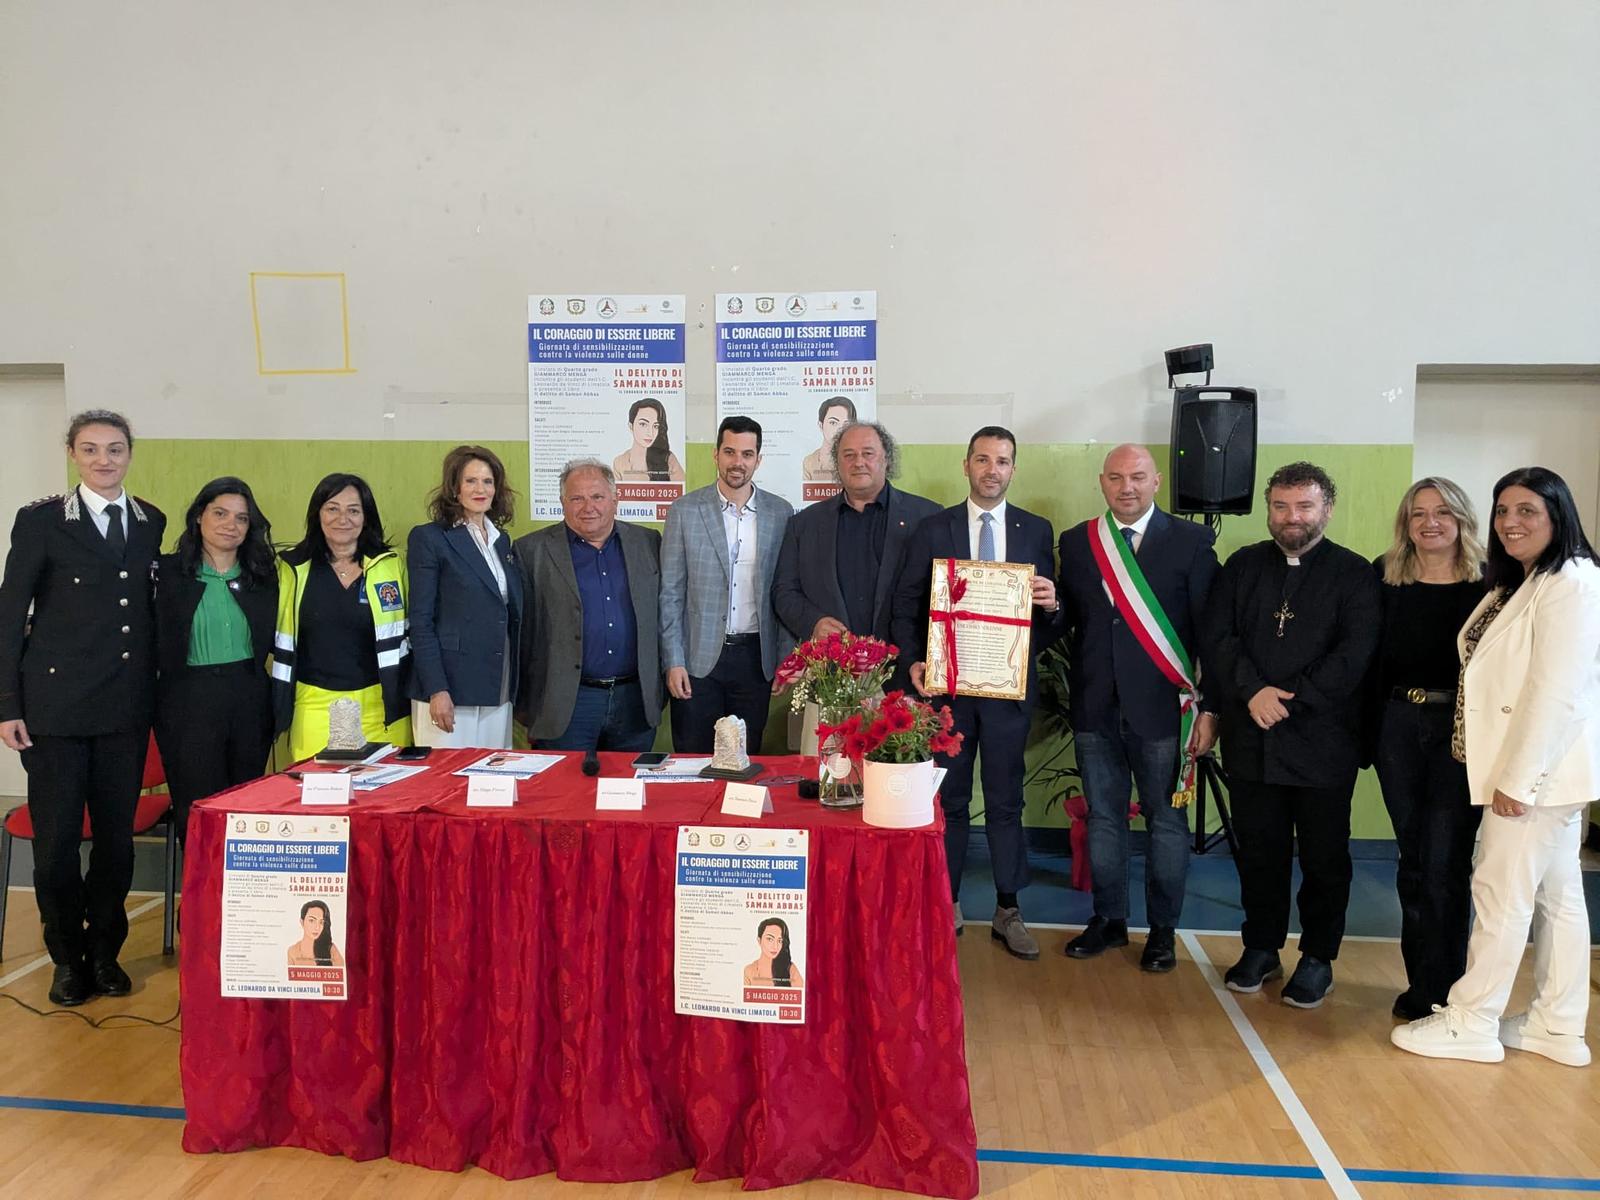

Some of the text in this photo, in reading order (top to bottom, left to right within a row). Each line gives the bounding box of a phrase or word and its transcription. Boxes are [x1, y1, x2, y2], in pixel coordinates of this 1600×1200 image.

[533, 328, 676, 340] IL CORAGGIO DI ESSERE LIBERE
[721, 326, 866, 339] IL CORAGGIO DI ESSERE LIBERE
[727, 342, 758, 350] Giornata
[771, 341, 834, 349] sensibilizzazione
[727, 350, 750, 358] contro
[615, 369, 682, 377] IL DELITTO DI
[804, 366, 873, 375] IL DELITTO DI
[613, 380, 683, 388] SAMAN ABBAS
[802, 377, 874, 387] SAMAN ABBAS
[617, 489, 678, 497] 5 MAGGIO 2025
[806, 488, 811, 497] 5
[620, 508, 653, 517] LIMATOLA
[230, 843, 339, 855] IL CORAGGIO DI ESSERE LIBERE
[682, 857, 798, 870] IL CORAGGIO DI ESSERE LIBERE
[686, 868, 711, 876] Giornata
[721, 870, 772, 878] sensibilizzazione
[318, 885, 344, 893] ABBAS
[746, 901, 804, 910] SAMAN ABBAS
[746, 991, 750, 999] 5
[780, 993, 798, 1001] 2025
[692, 1004, 720, 1012] LEONARDO
[731, 1007, 747, 1015] VINCI
